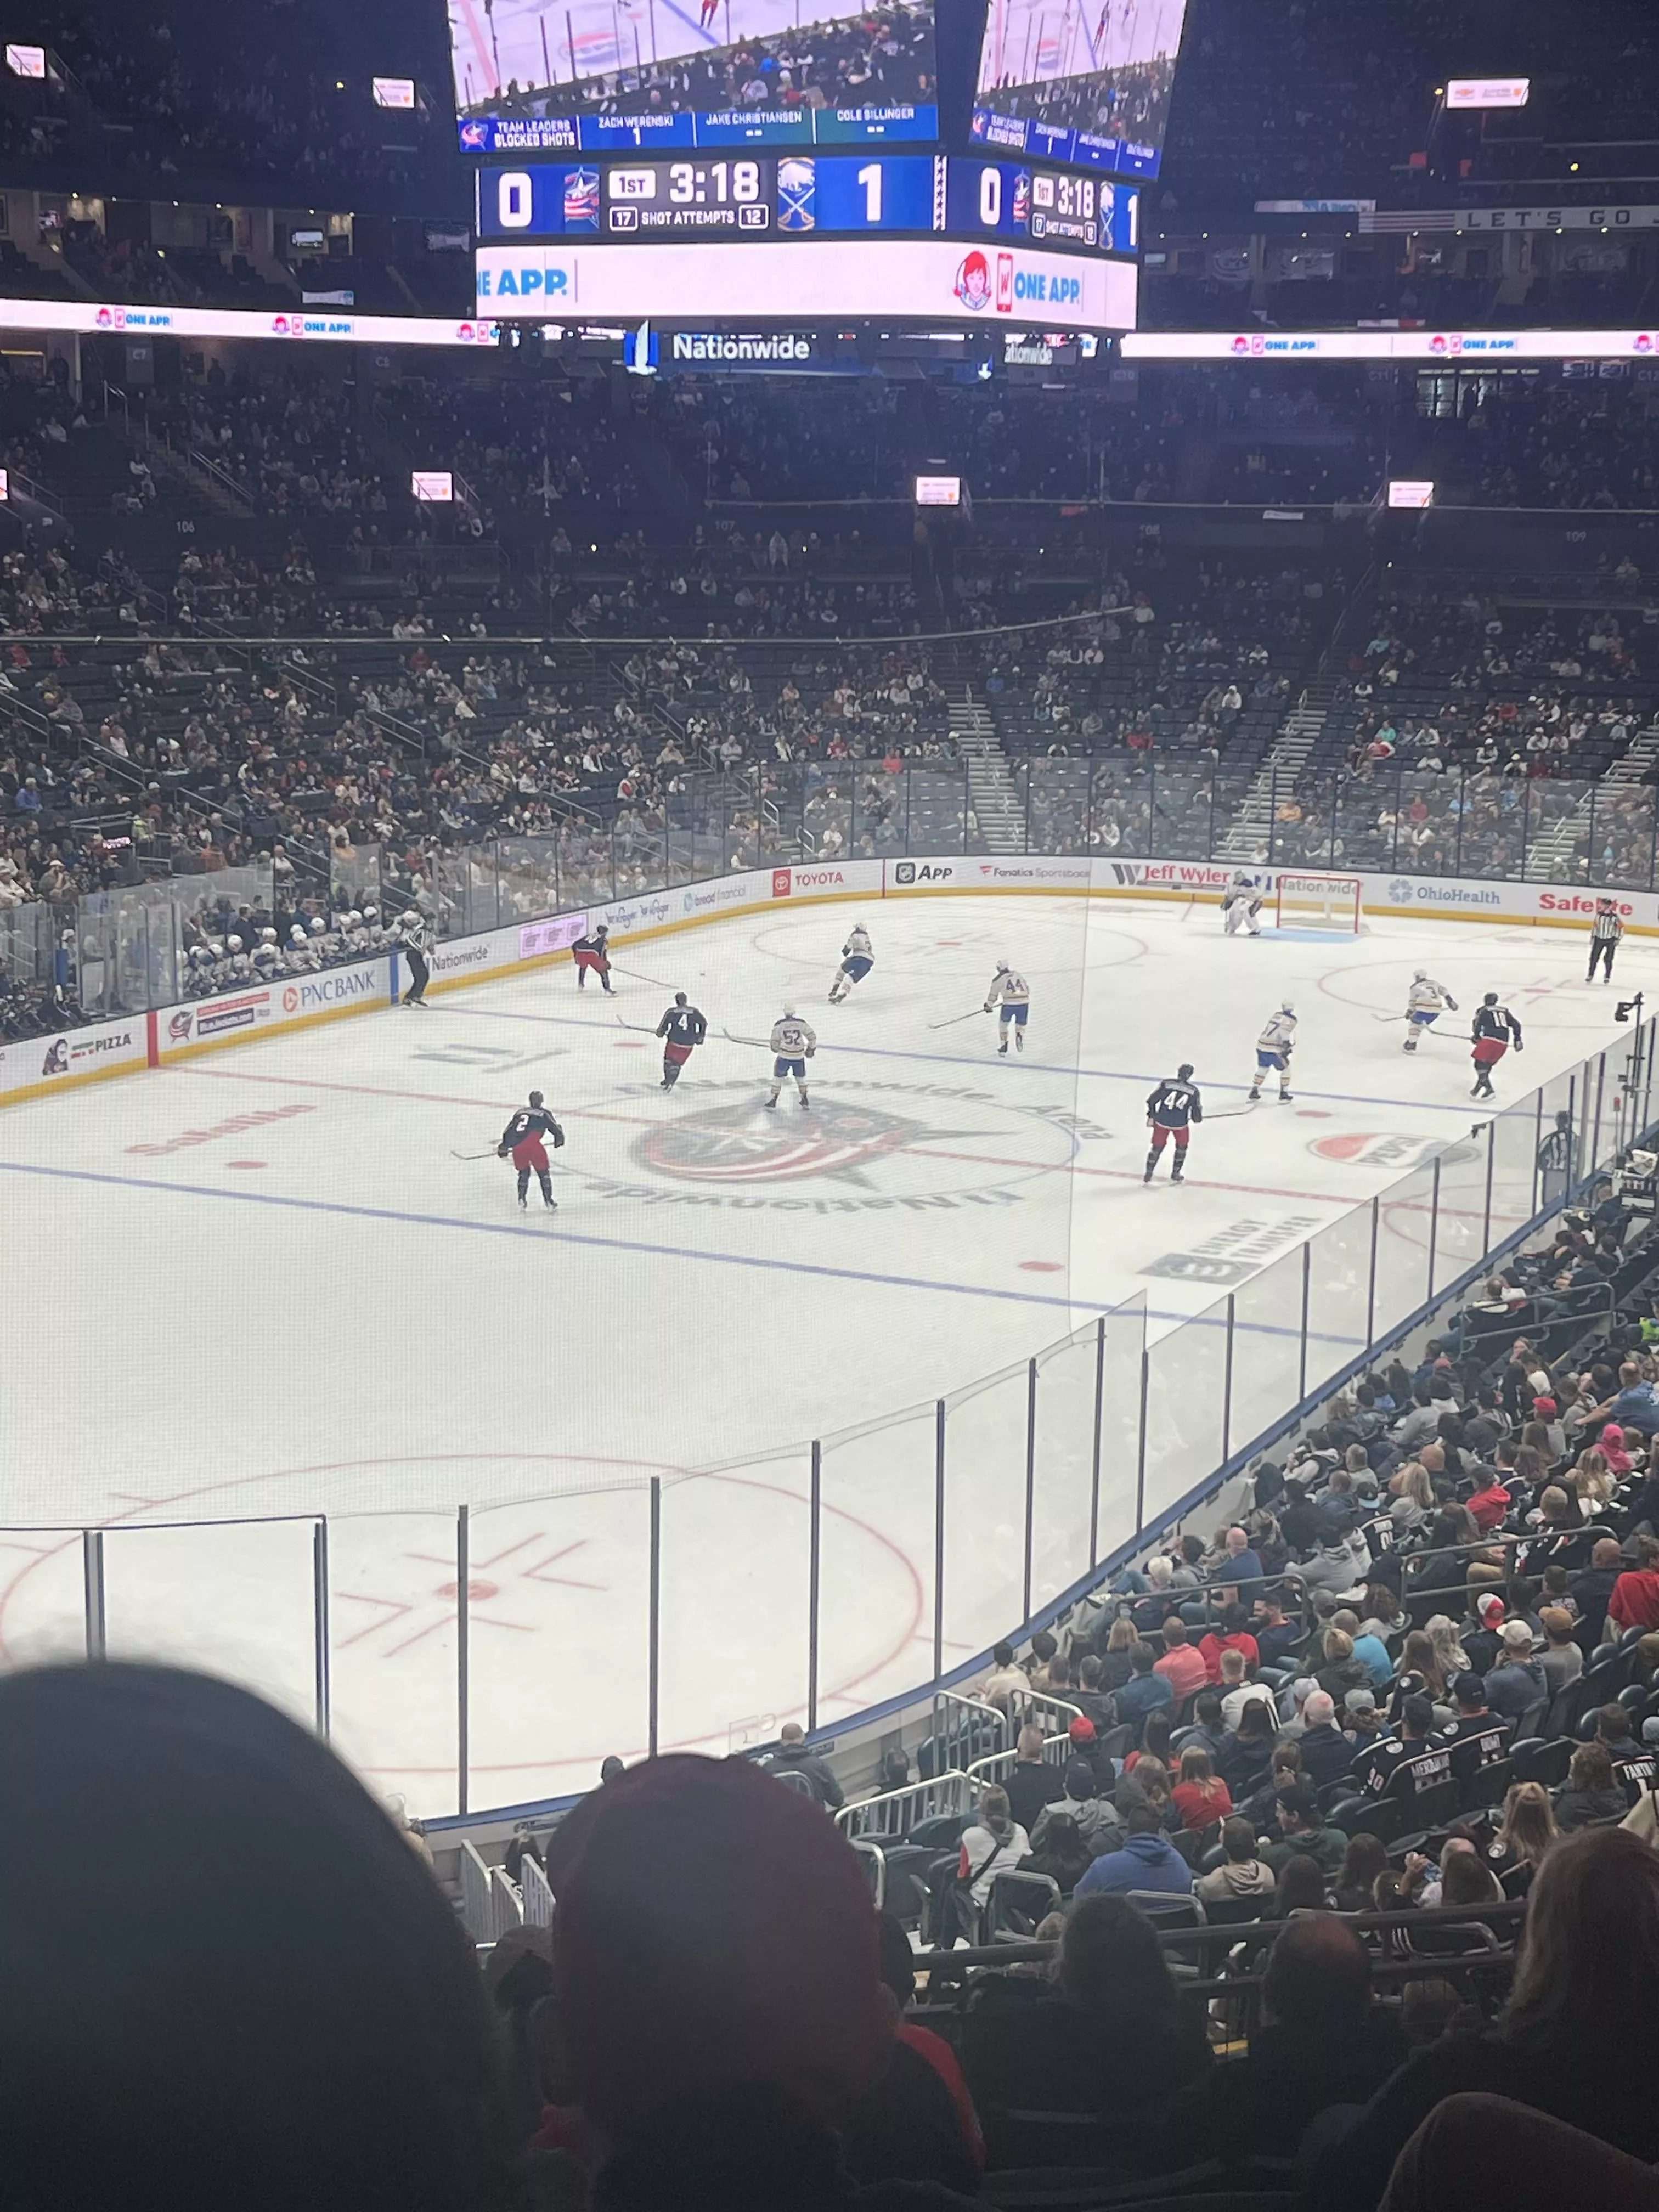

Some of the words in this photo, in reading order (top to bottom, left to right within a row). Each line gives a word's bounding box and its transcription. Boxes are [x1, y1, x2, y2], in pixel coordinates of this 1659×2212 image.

[496, 121, 524, 132] TEAM
[541, 131, 575, 146] SHOTS
[632, 128, 641, 145] 1
[618, 175, 646, 194] 1ST
[669, 161, 760, 203] 3:18
[499, 172, 532, 227] 0
[857, 163, 882, 222] 1
[980, 167, 1002, 225] 0
[1057, 176, 1094, 218] 3:18
[616, 212, 631, 225] 17
[641, 211, 672, 225] SHOT
[673, 208, 735, 225] ATTEMPTS
[746, 209, 761, 224] 12
[1127, 194, 1138, 246] 1
[1466, 210, 1562, 228] LET'S
[1589, 209, 1631, 225] GO
[1014, 271, 1046, 300] ONE
[673, 332, 810, 360] Nationwide
[176, 521, 195, 533] 106
[715, 520, 736, 532] 107
[794, 871, 844, 886] TOYOTA
[1143, 865, 1175, 882] Jeff
[1179, 867, 1231, 888] Wyler
[1417, 886, 1501, 905] OhioHealth
[1538, 893, 1633, 916] Safelte
[431, 945, 489, 971] Nationwide
[301, 982, 334, 1006] PNC
[336, 970, 376, 997] BANK
[678, 1014, 689, 1031] 4
[95, 1033, 132, 1053] PIZZA
[783, 1029, 801, 1045] 52
[1164, 1091, 1189, 1110] 44
[516, 1114, 529, 1132] 2
